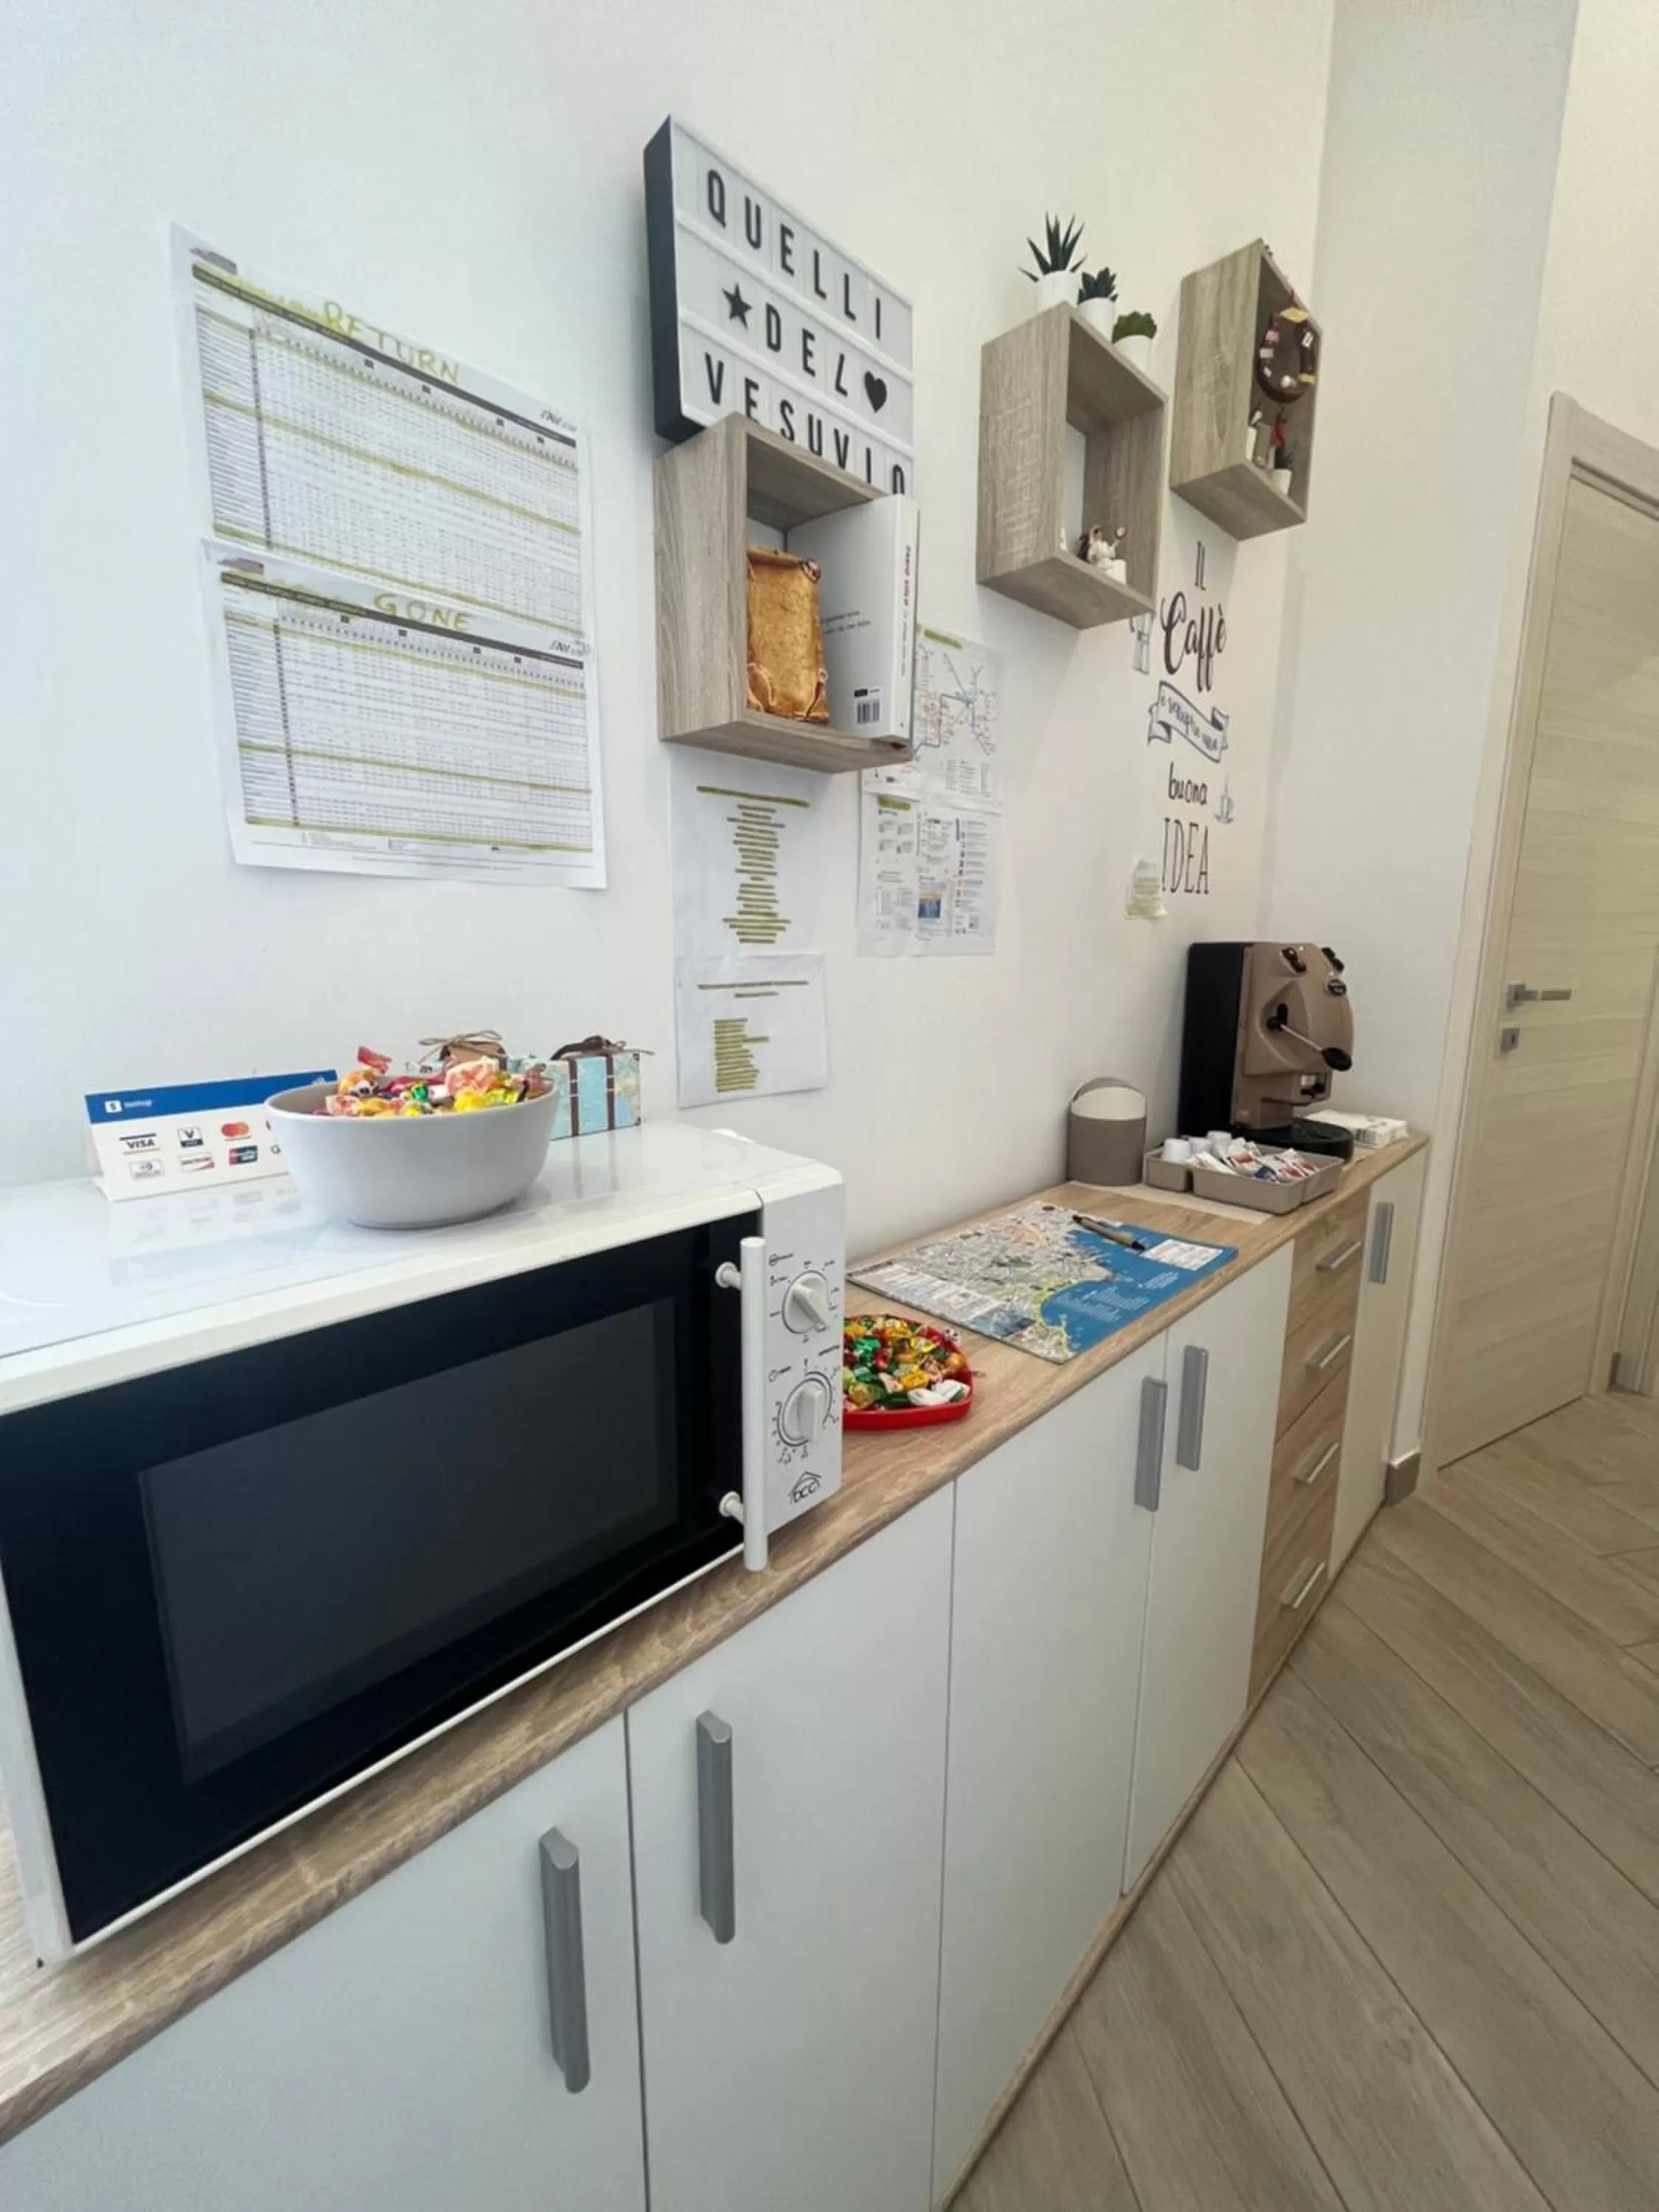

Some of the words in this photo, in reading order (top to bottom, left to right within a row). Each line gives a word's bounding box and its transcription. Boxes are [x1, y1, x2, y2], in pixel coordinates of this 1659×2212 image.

[707, 169, 881, 340] QUELLI
[324, 300, 459, 385] RETURN
[765, 302, 849, 397] DEL
[373, 593, 470, 630] GONE
[1159, 591, 1227, 692] Caffè
[1168, 761, 1208, 805] buona
[1161, 817, 1210, 895] IDEA
[126, 1138, 155, 1150] VISA
